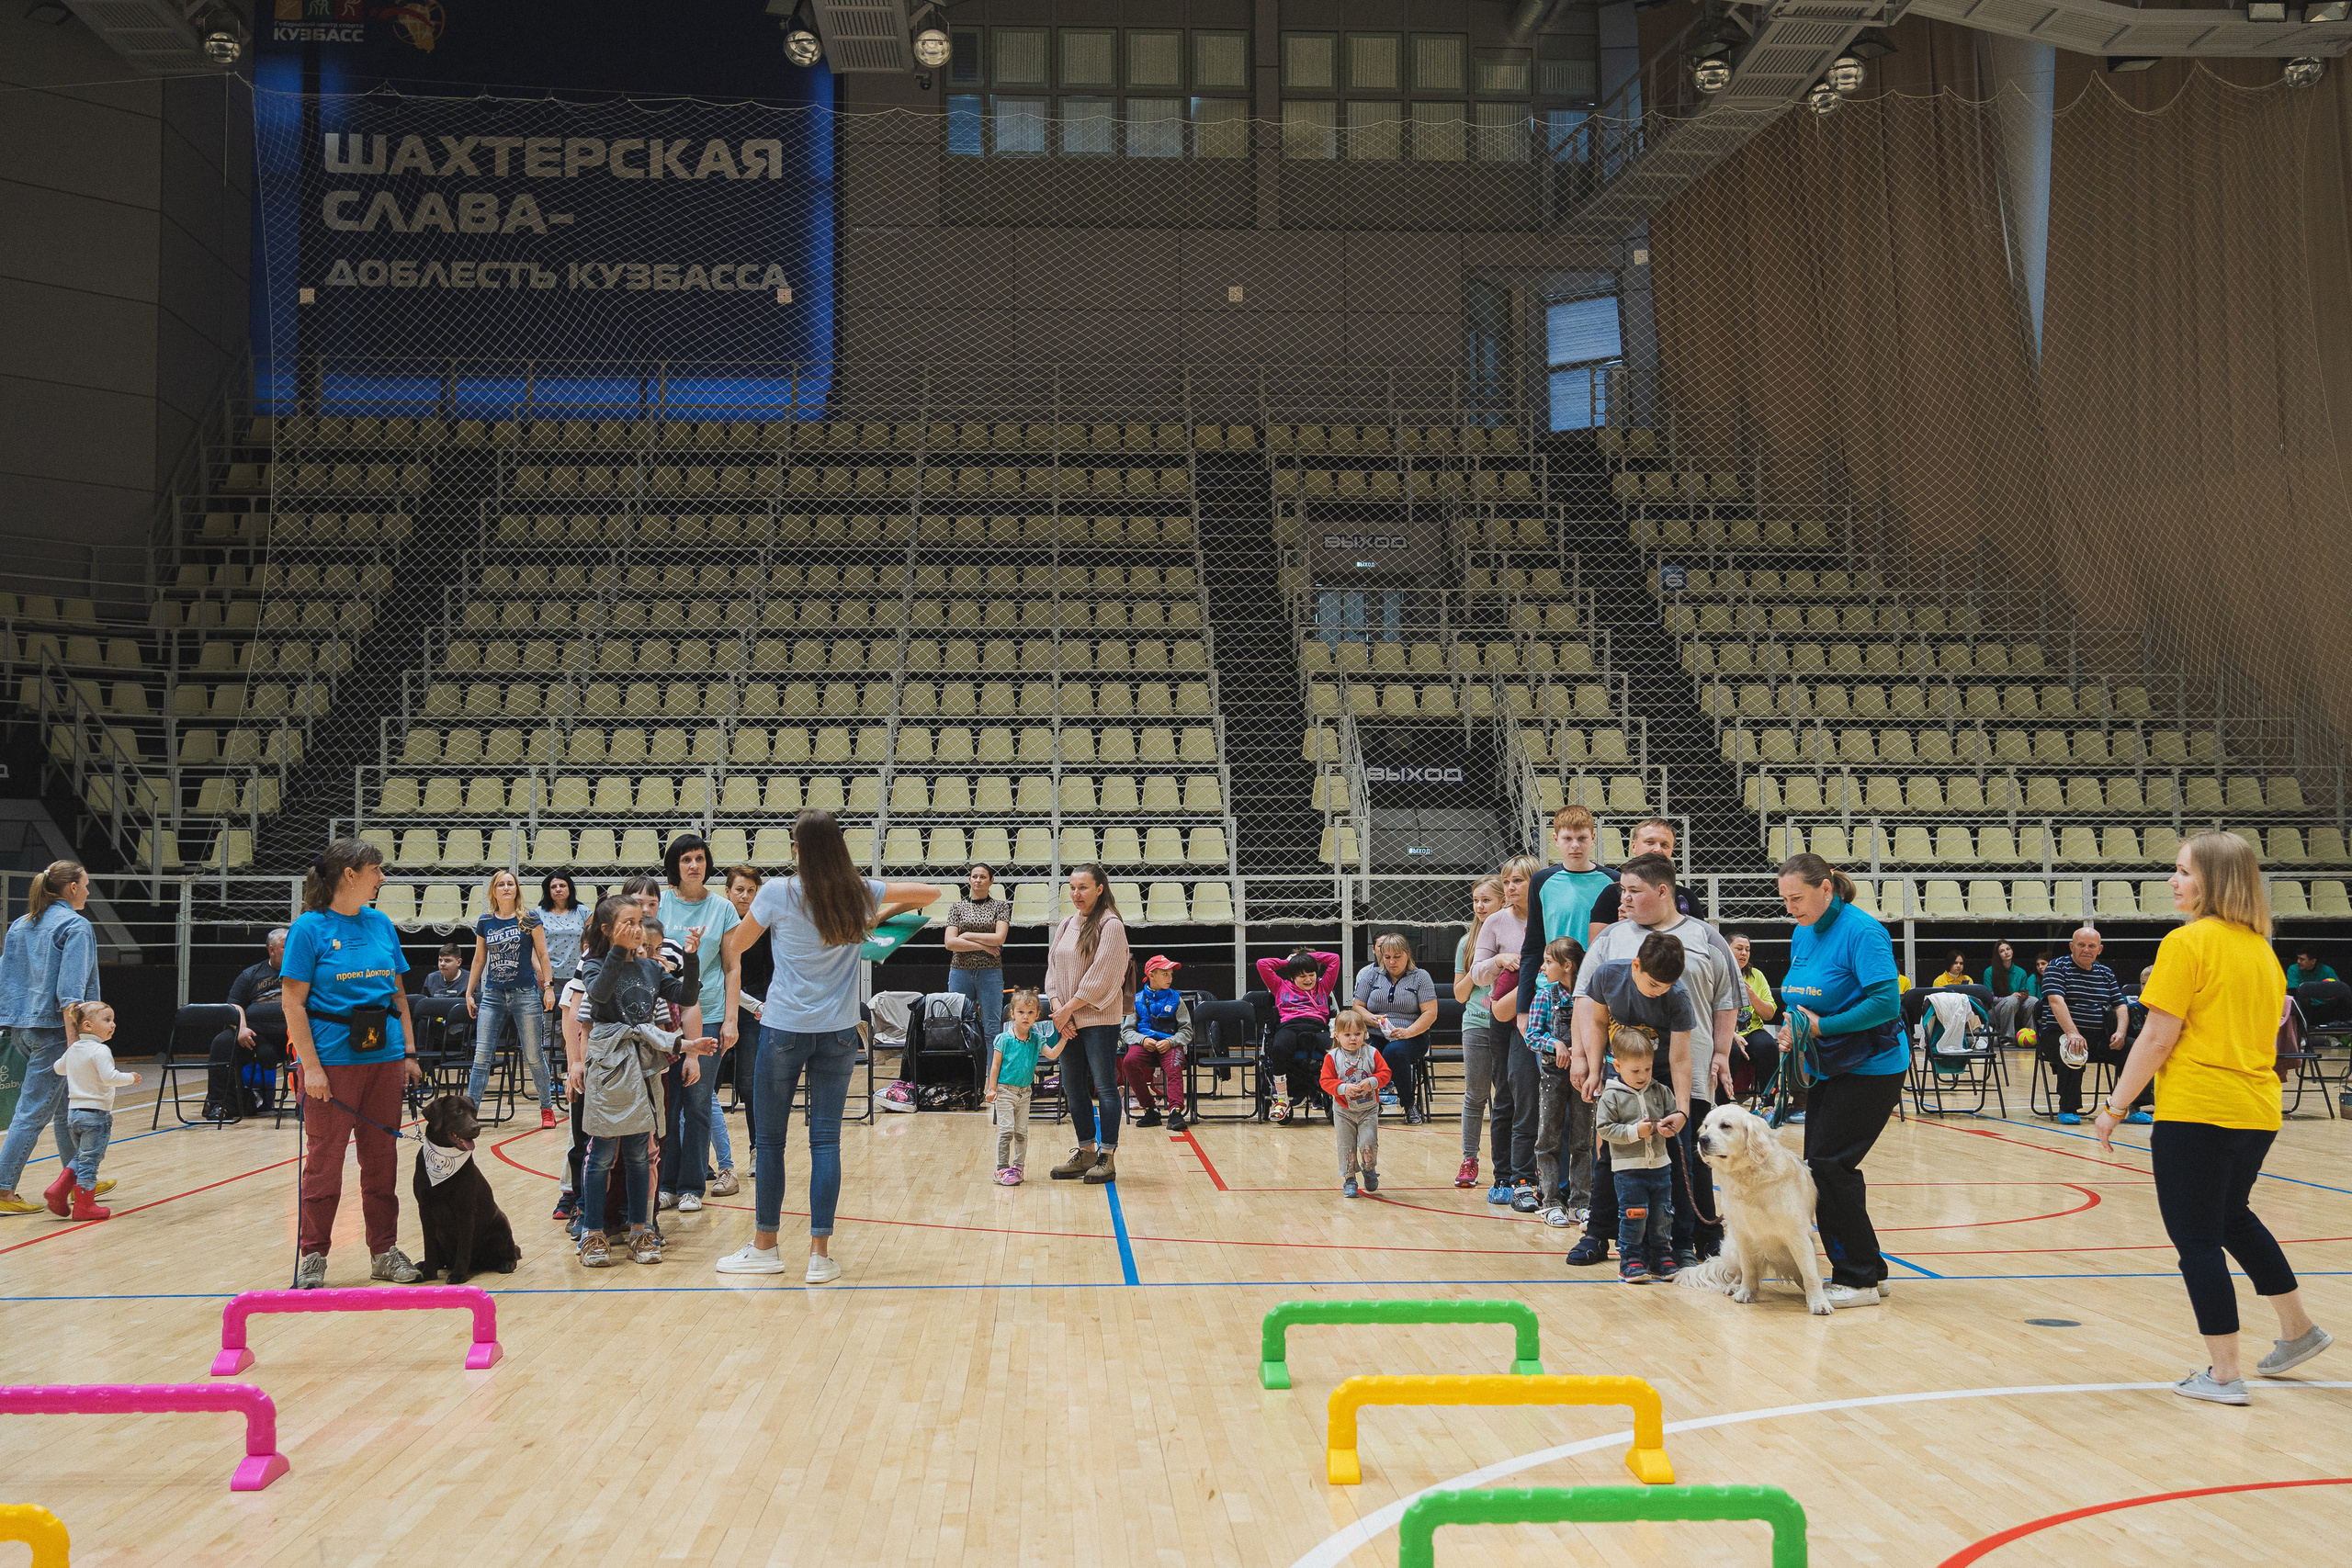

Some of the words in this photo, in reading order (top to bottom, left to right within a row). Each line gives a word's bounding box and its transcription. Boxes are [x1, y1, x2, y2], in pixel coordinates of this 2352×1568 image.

[274, 28, 364, 42] КУЗБАСС
[325, 133, 783, 179] ШАХТЕРСКАЯ
[322, 190, 575, 233] СЛАВА-
[325, 259, 558, 289] ДОБЛЕСТЬ
[568, 262, 789, 291] КУЗБАССА
[1324, 536, 1408, 548] ВЫХОД
[1366, 767, 1464, 782] ВЫХОД
[505, 928, 521, 938] FUN
[500, 942, 521, 953] Day
[490, 959, 520, 970] HALLENGE
[336, 971, 364, 982] проект
[366, 968, 390, 978] Доктор
[1806, 986, 1823, 997] Пёс
